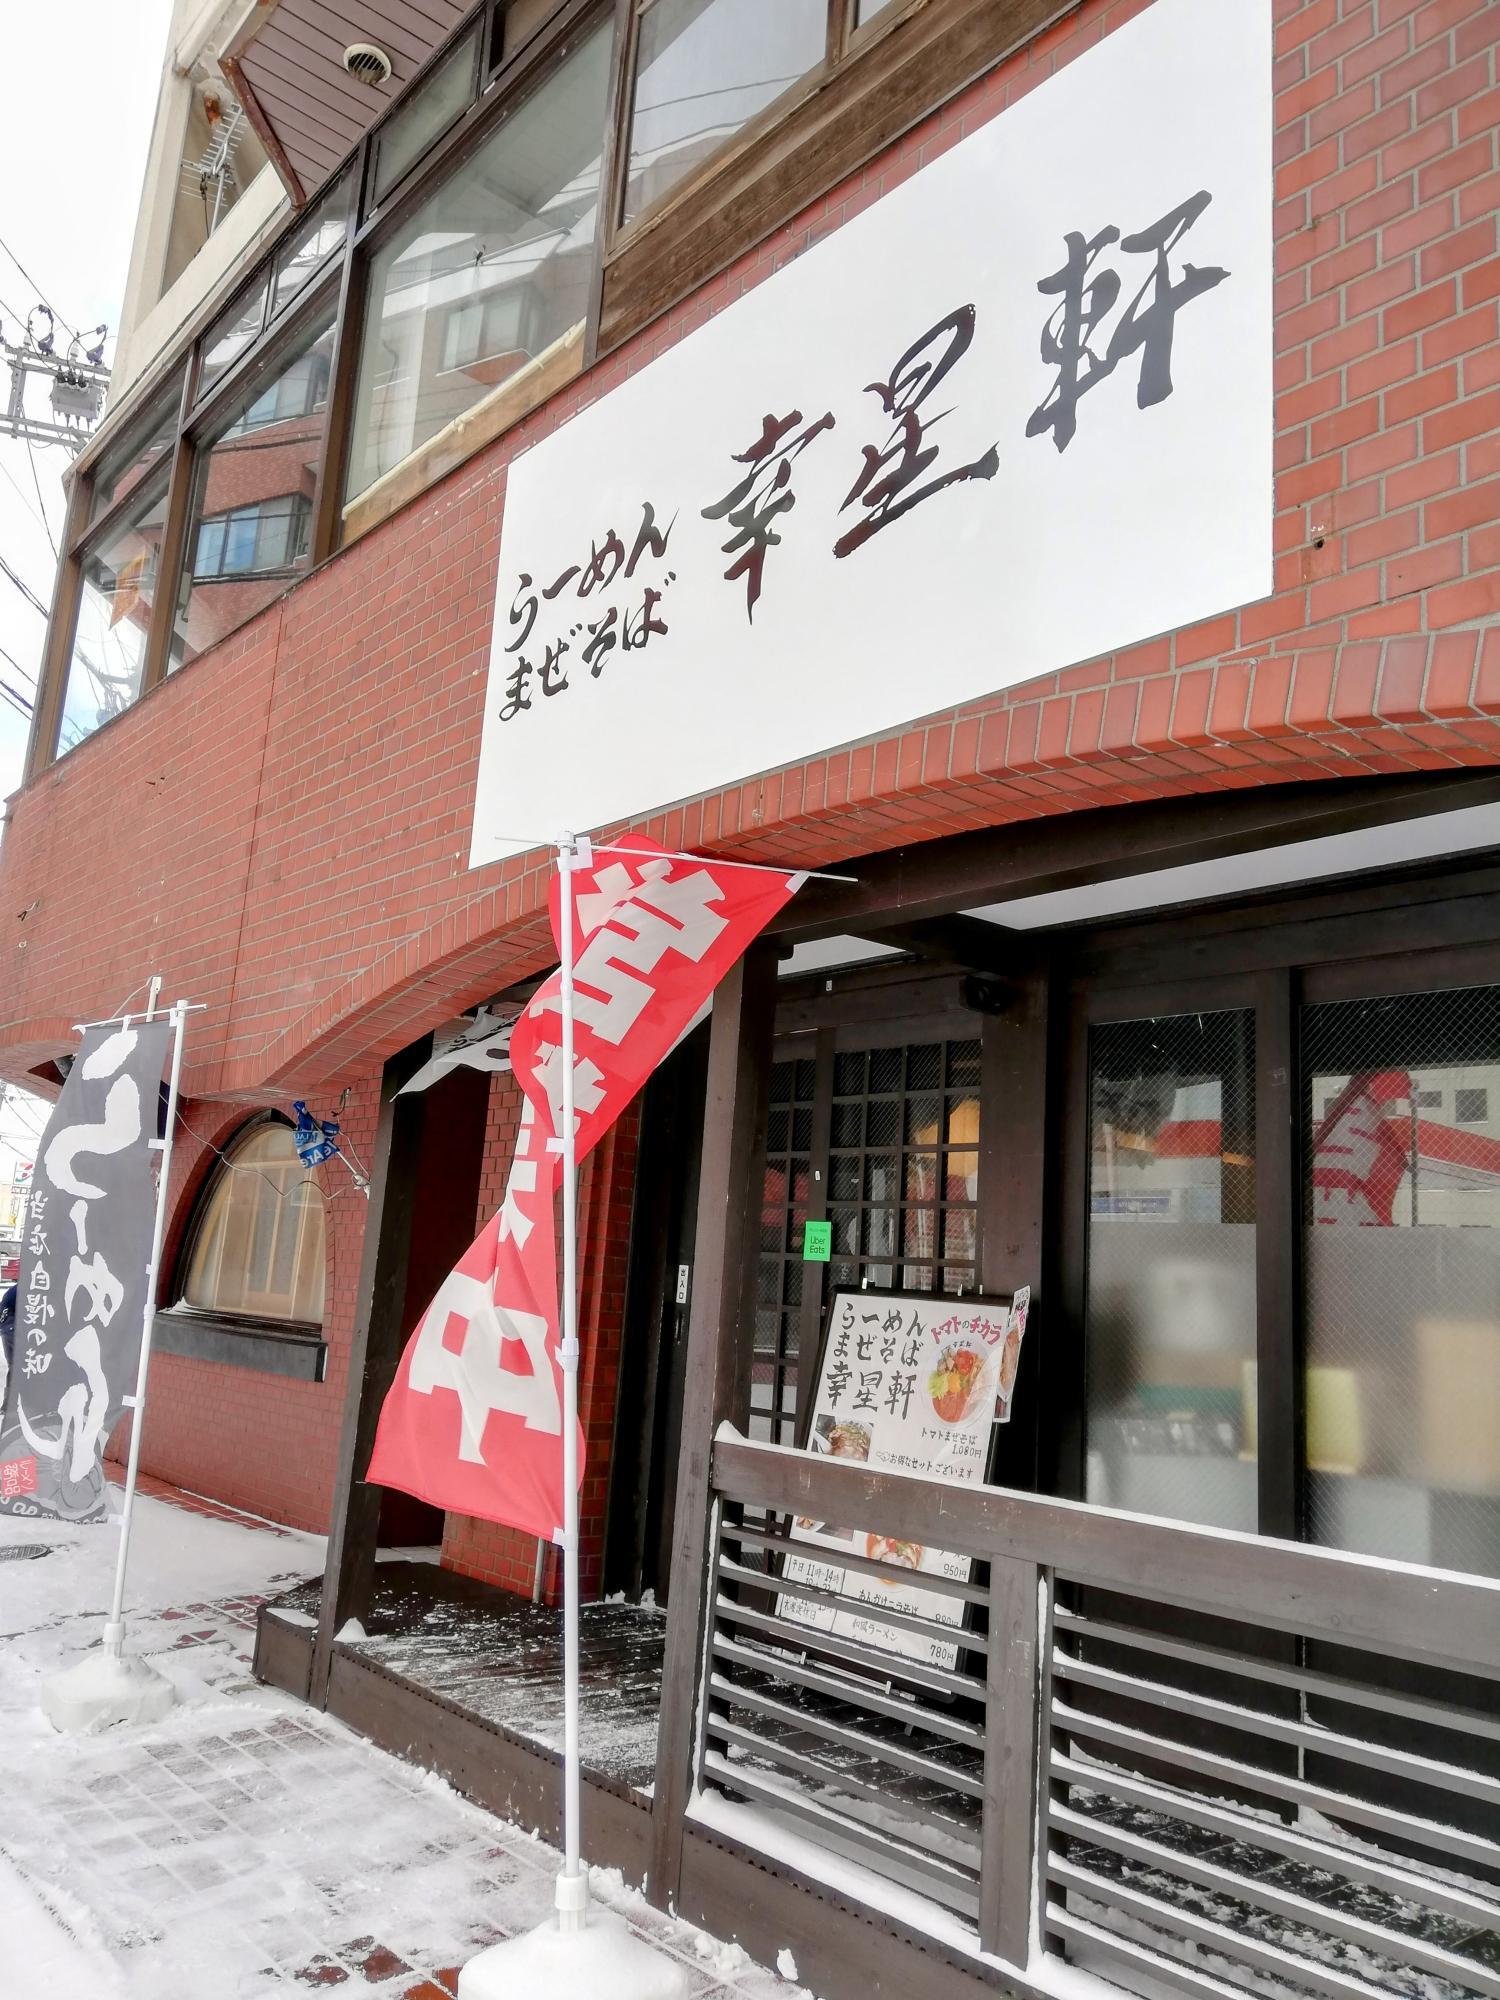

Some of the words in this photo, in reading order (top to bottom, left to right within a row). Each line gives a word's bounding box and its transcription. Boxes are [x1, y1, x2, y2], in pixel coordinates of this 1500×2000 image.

[506, 502, 680, 652] らーめん
[499, 570, 677, 722] まぜそば
[809, 1245, 825, 1254] Eats
[810, 1235, 826, 1245] Uber
[678, 1268, 687, 1299] 出入口
[841, 1302, 928, 1337] らーめん
[931, 1315, 1003, 1346] トマトのチカラ
[833, 1331, 924, 1367] まぜそば
[921, 1427, 978, 1446] トマトまぜそば
[889, 1453, 933, 1472] お得なセット
[943, 1563, 967, 1579] 950円
[929, 1643, 954, 1663] 780円
